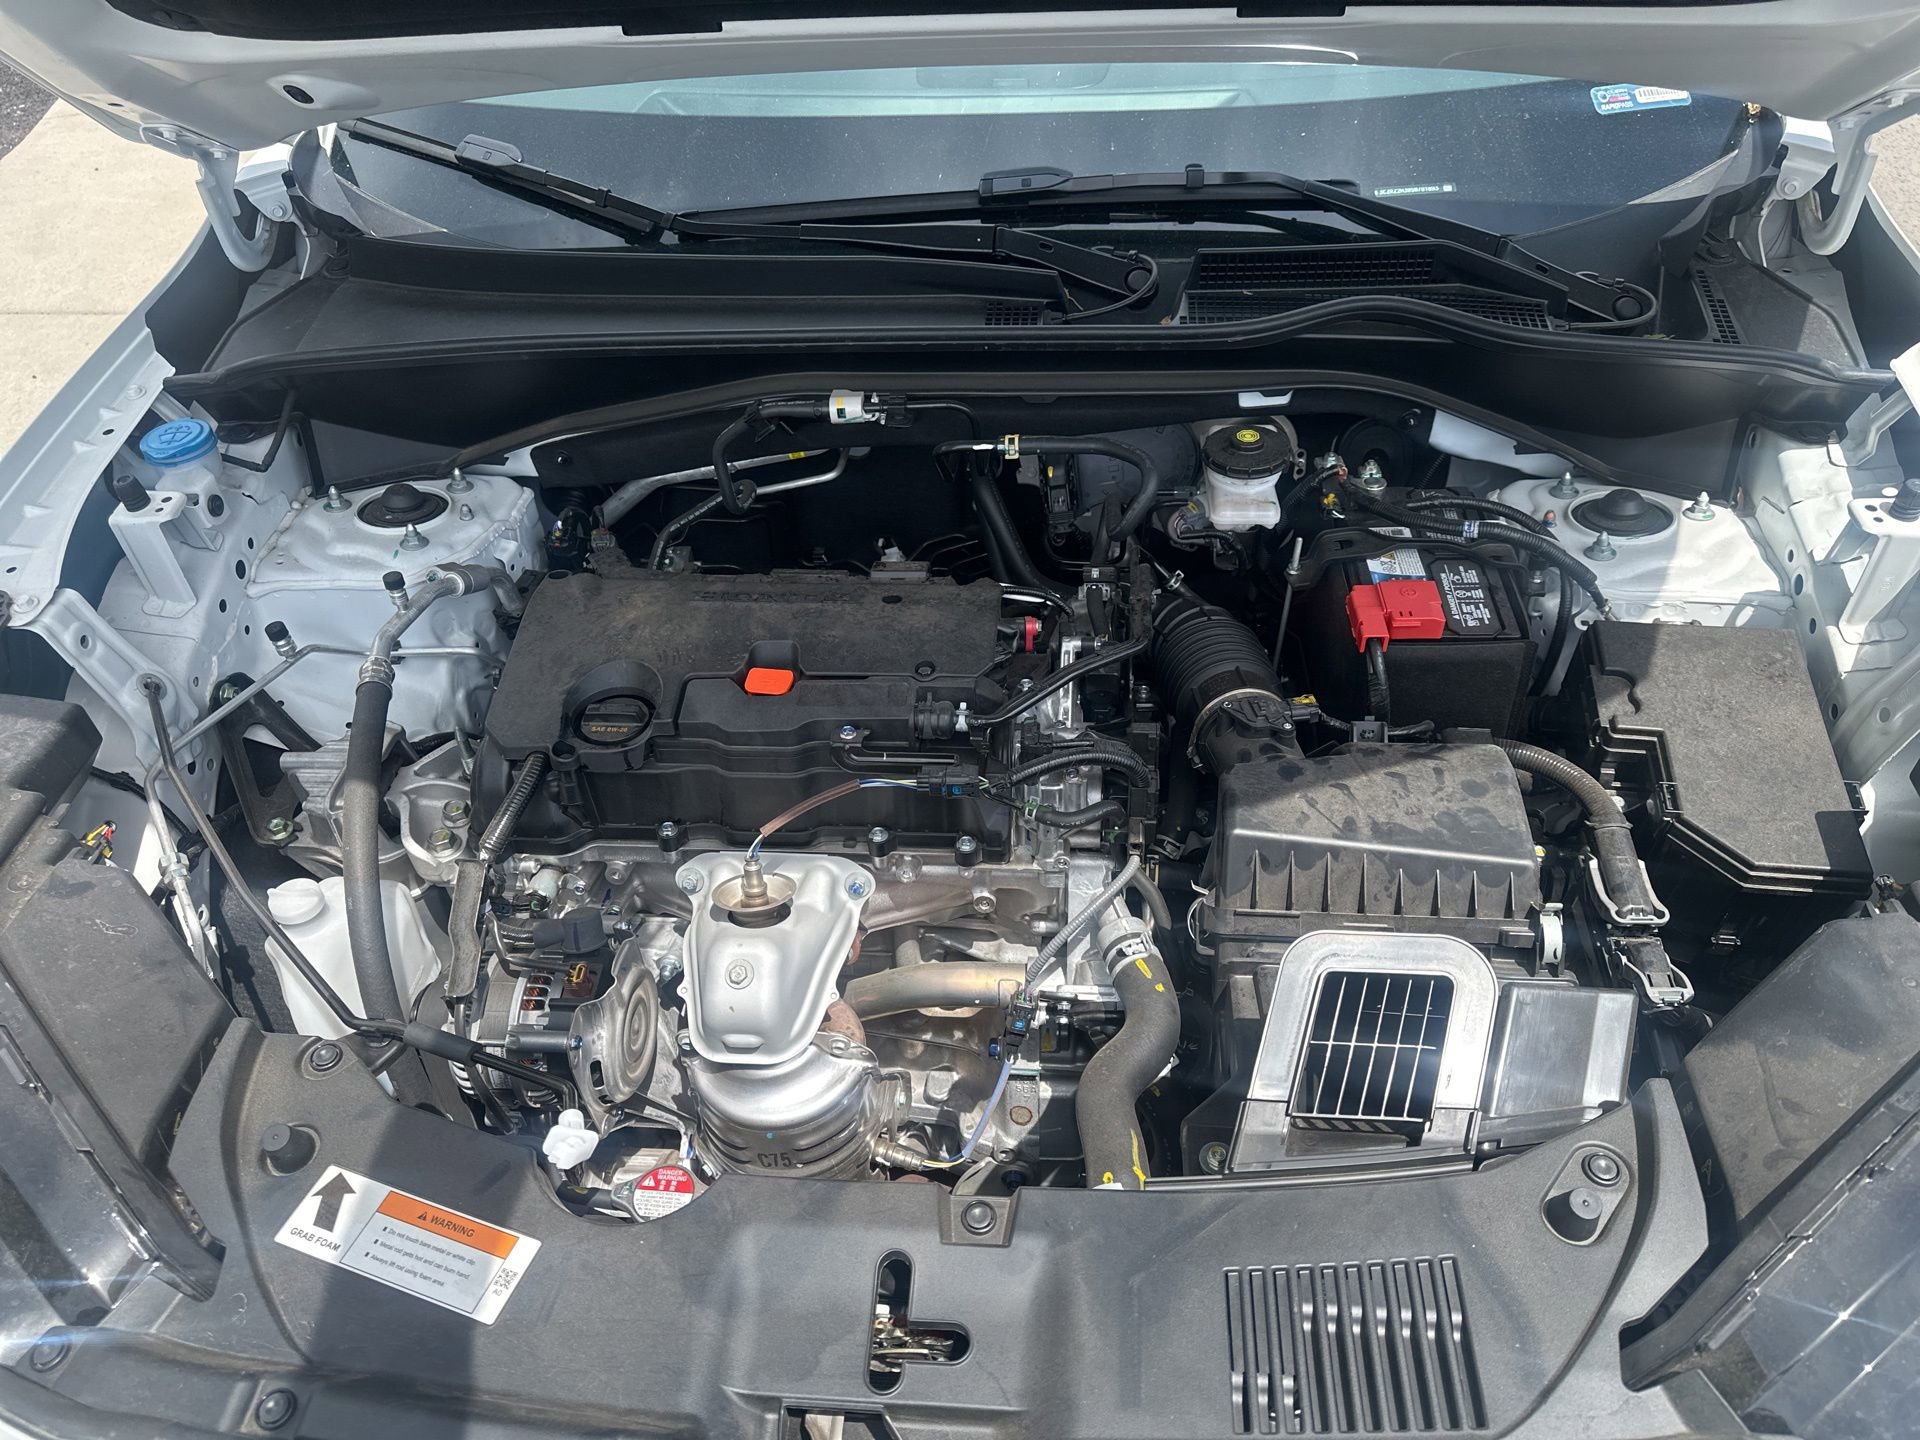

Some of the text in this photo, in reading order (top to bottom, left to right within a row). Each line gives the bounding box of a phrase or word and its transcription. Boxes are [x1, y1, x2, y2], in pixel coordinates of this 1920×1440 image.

[757, 1152, 792, 1168] C75
[430, 1215, 475, 1238] WARNING
[290, 1227, 342, 1252] GRAB FOAM
